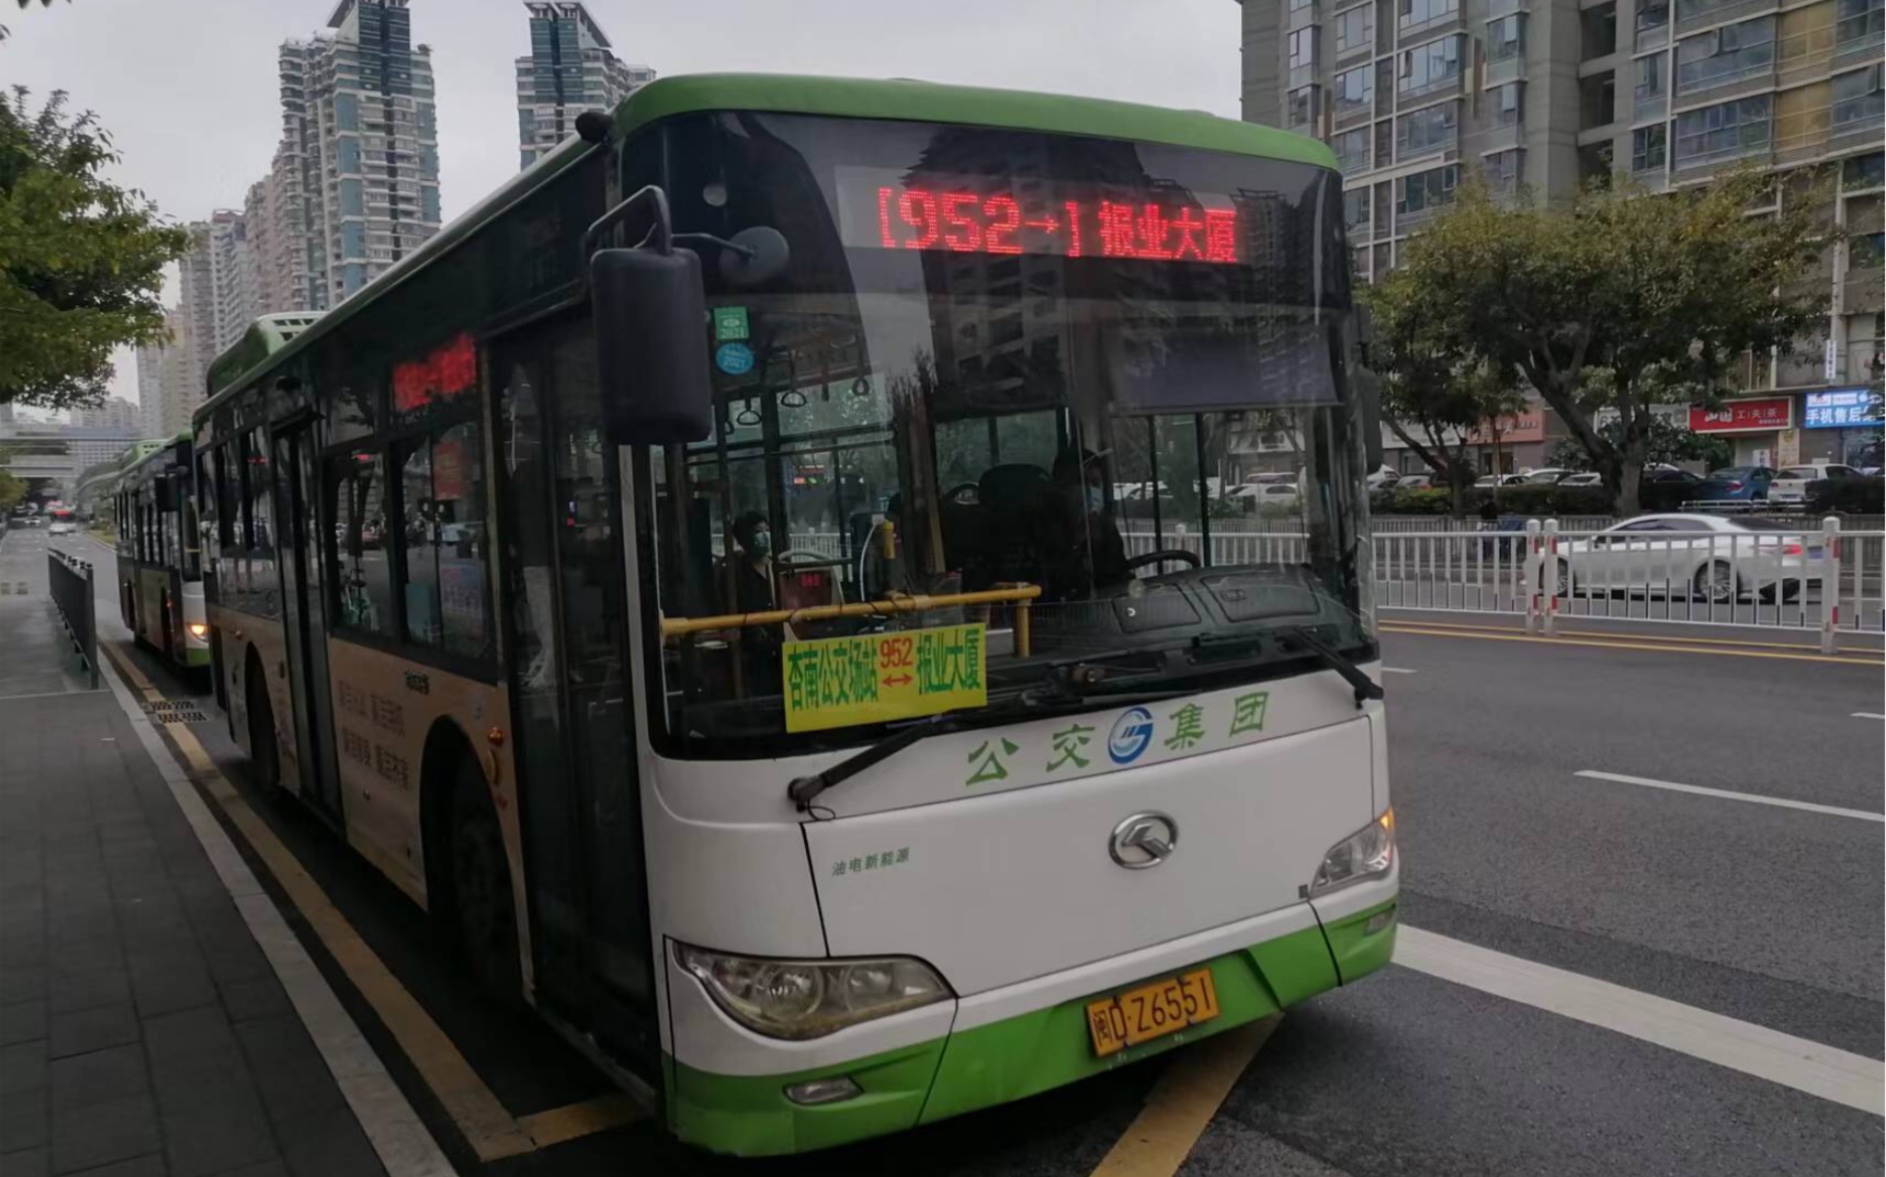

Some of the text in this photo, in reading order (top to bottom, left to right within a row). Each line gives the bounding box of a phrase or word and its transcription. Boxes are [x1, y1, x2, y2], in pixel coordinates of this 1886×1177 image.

[1099, 201, 1237, 263] 报业大厦
[788, 628, 981, 712] 杏南公交场站 952 报业大厦
[831, 847, 910, 877] 油电新能源
